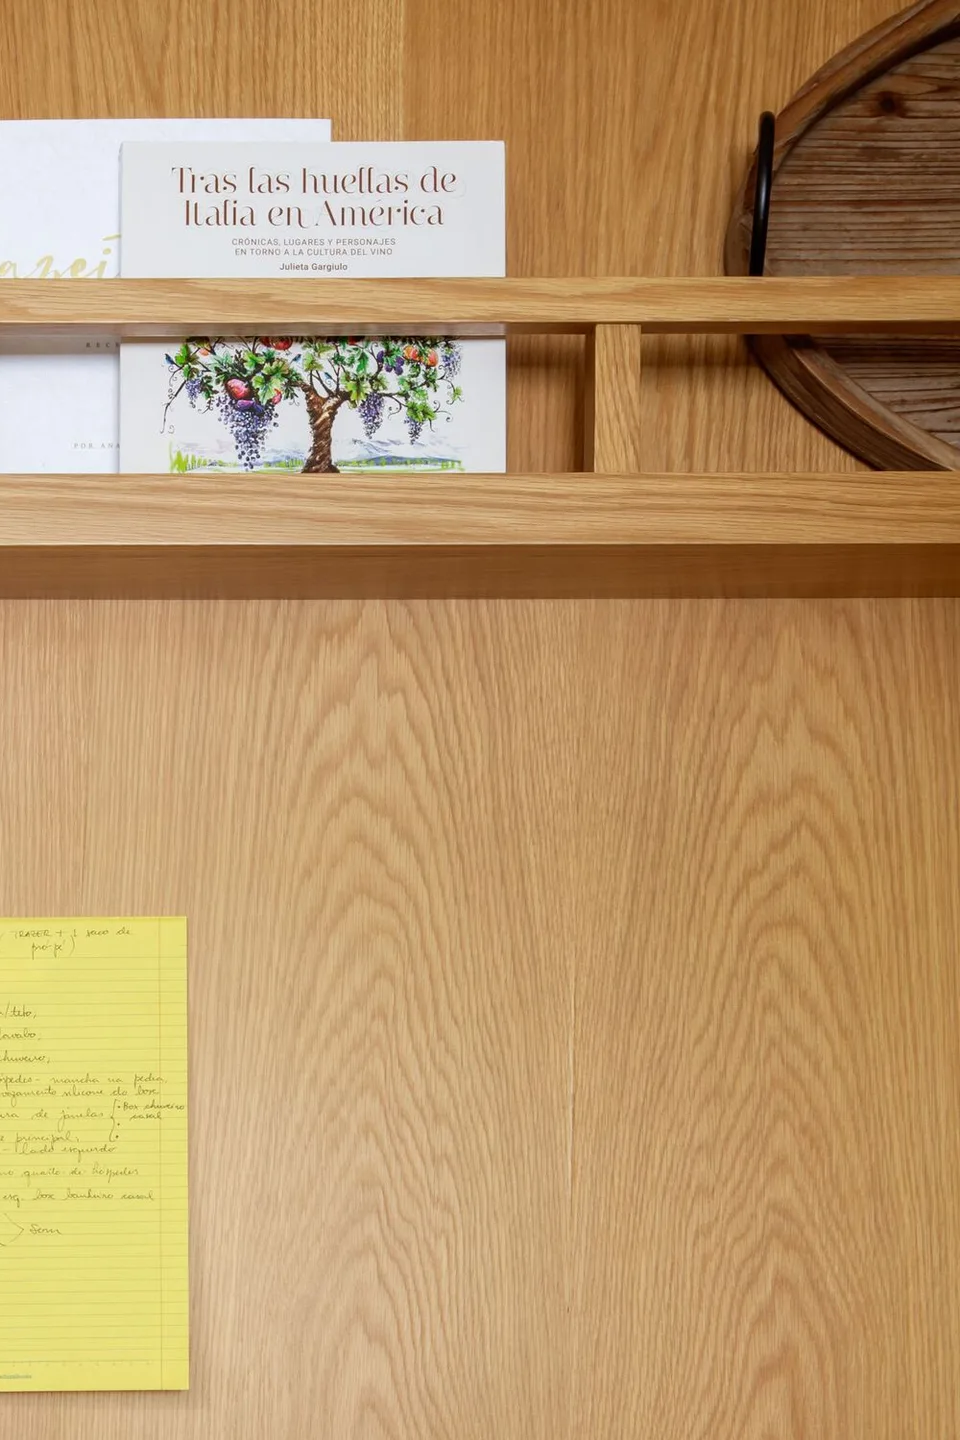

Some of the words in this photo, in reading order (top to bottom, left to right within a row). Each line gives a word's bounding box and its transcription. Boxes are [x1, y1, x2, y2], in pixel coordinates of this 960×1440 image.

[171, 166, 237, 194] Tras
[248, 166, 291, 194] las
[301, 166, 409, 195] huellas
[419, 165, 458, 193] de
[184, 199, 257, 227] Italia
[267, 205, 310, 229] en
[313, 198, 445, 228] América
[231, 236, 281, 248] CRÓNICAS,
[283, 238, 326, 247] LUGARES
[328, 238, 334, 247] Y
[336, 238, 397, 247] PERSONAJES
[234, 248, 248, 257] EN
[250, 248, 281, 257] TORNO
[283, 248, 290, 257] A
[292, 248, 305, 257] LA
[307, 248, 349, 257] CULTURA
[350, 248, 369, 257] DEL
[371, 248, 394, 257] VINO
[279, 262, 309, 272] Julieta
[311, 262, 348, 273] Gargiulo
